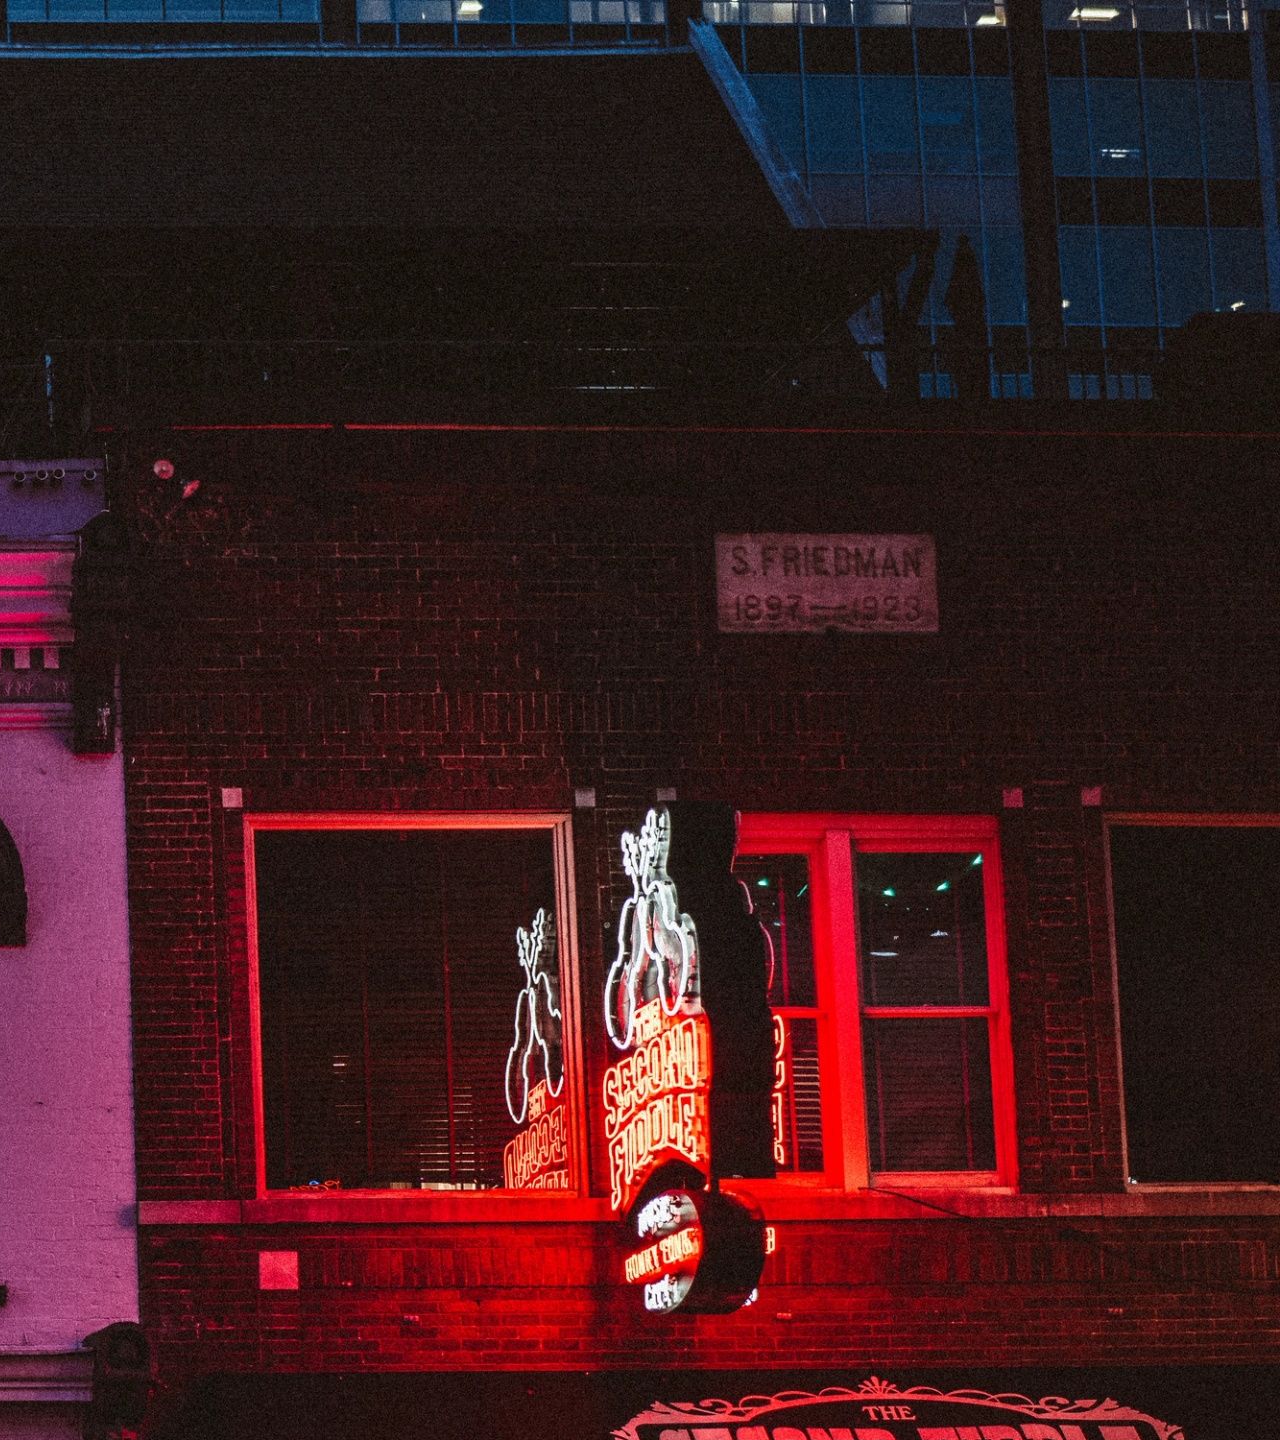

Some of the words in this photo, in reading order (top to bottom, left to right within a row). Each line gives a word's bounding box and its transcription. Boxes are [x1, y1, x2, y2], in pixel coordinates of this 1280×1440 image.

[633, 997, 661, 1046] THE
[603, 1018, 698, 1139] SECOND
[608, 1093, 699, 1211] FIDDLE
[861, 1404, 917, 1422] THE
